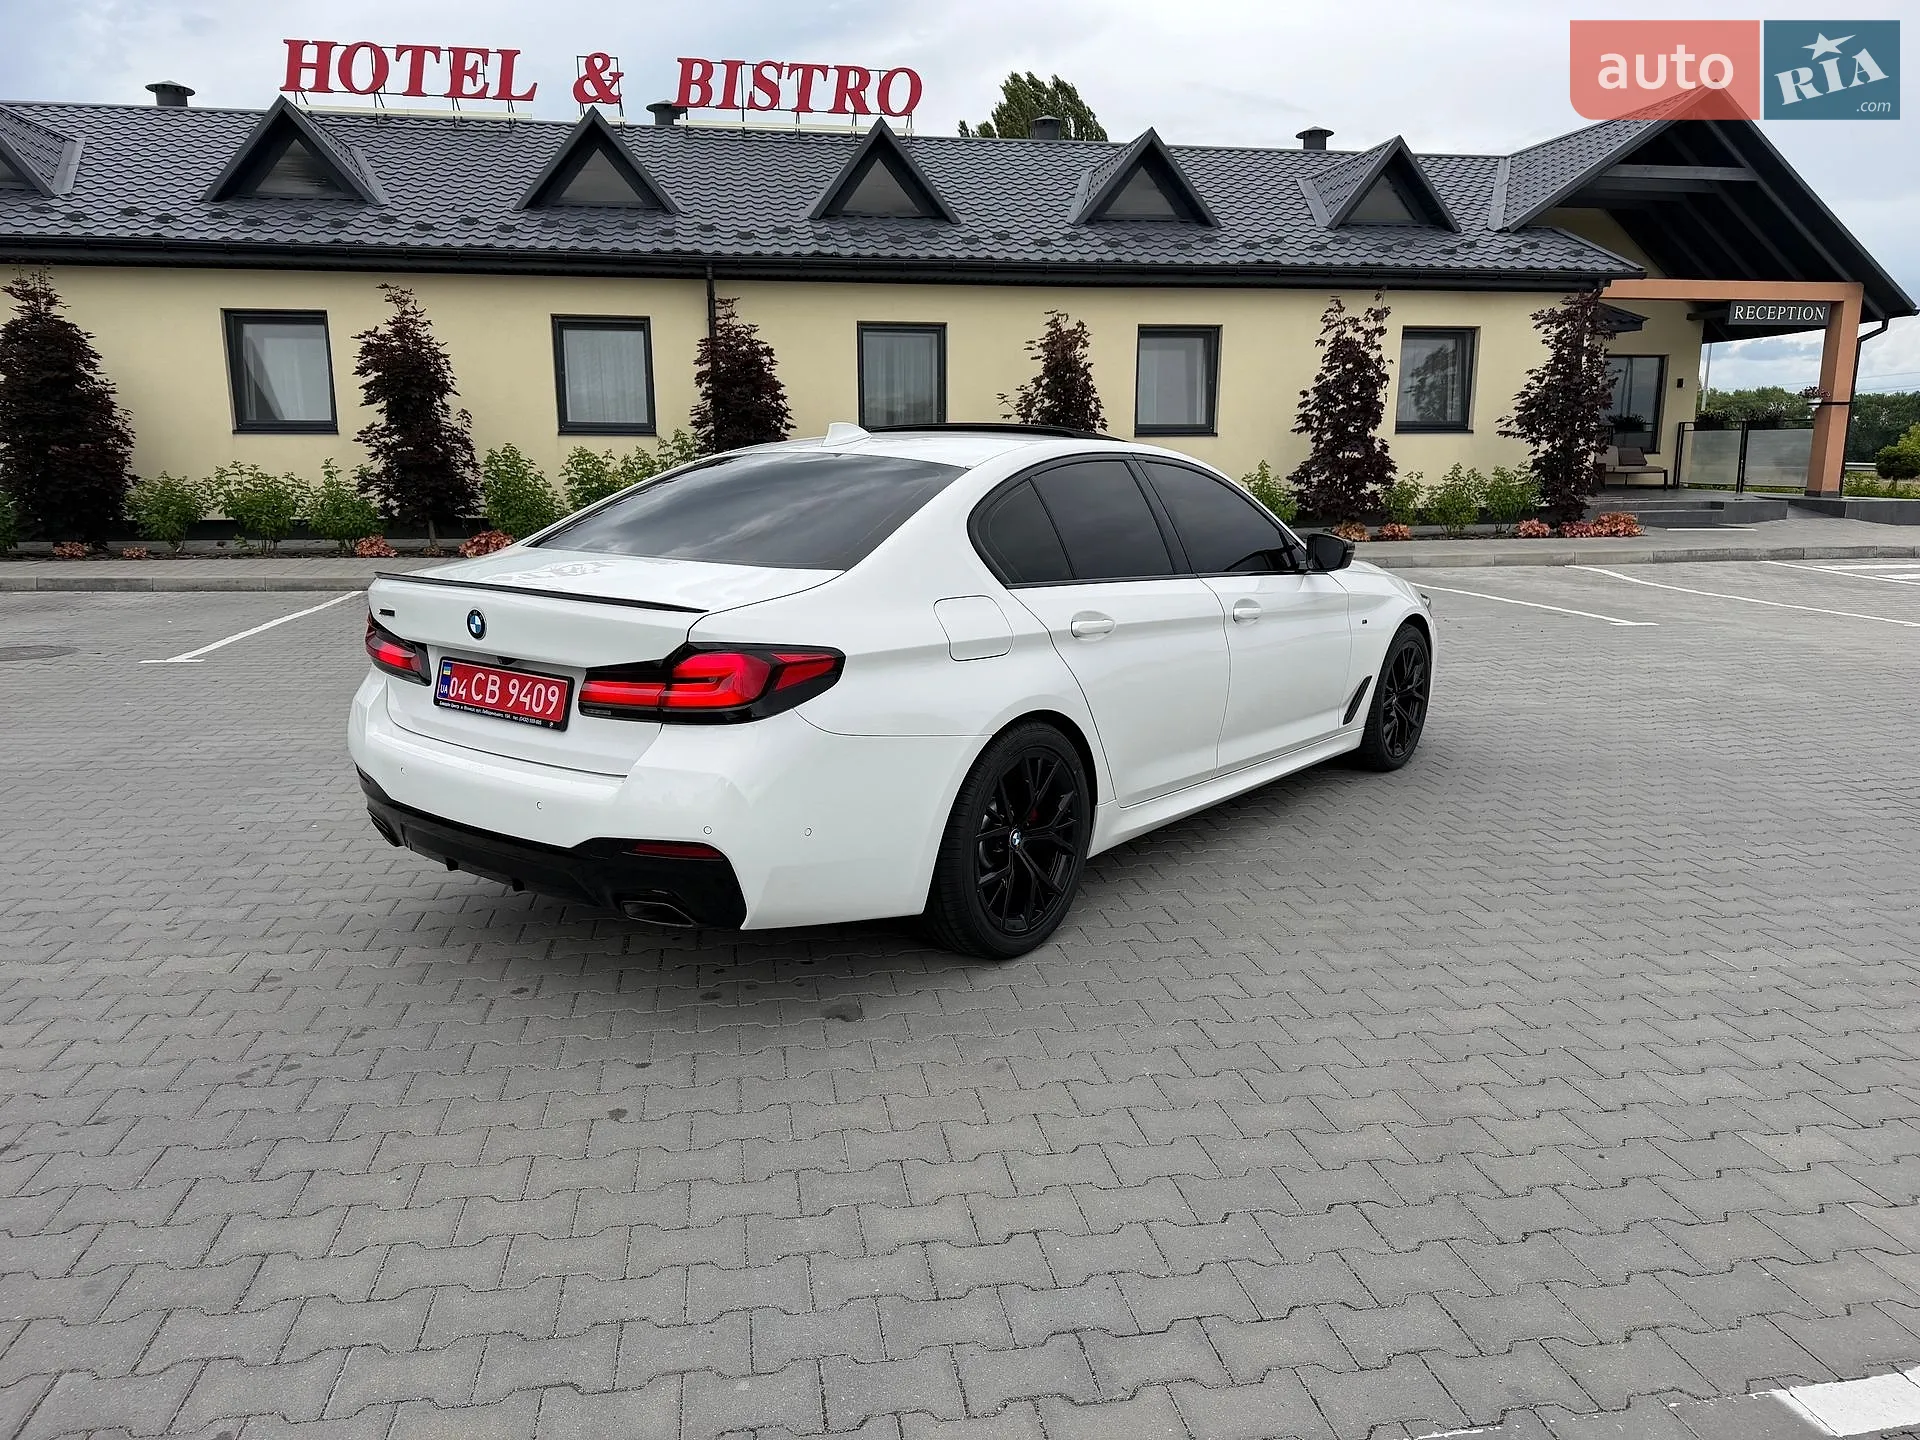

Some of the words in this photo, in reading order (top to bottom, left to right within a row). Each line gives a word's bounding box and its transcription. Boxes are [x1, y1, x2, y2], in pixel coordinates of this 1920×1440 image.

[280, 38, 537, 101] HOTEL
[573, 52, 624, 104] &
[671, 57, 922, 116] BISTRO
[1733, 304, 1827, 321] RECEPTION
[440, 684, 448, 695] UA
[449, 676, 467, 700] 04
[471, 672, 501, 704] CB
[506, 678, 560, 715] 9409
